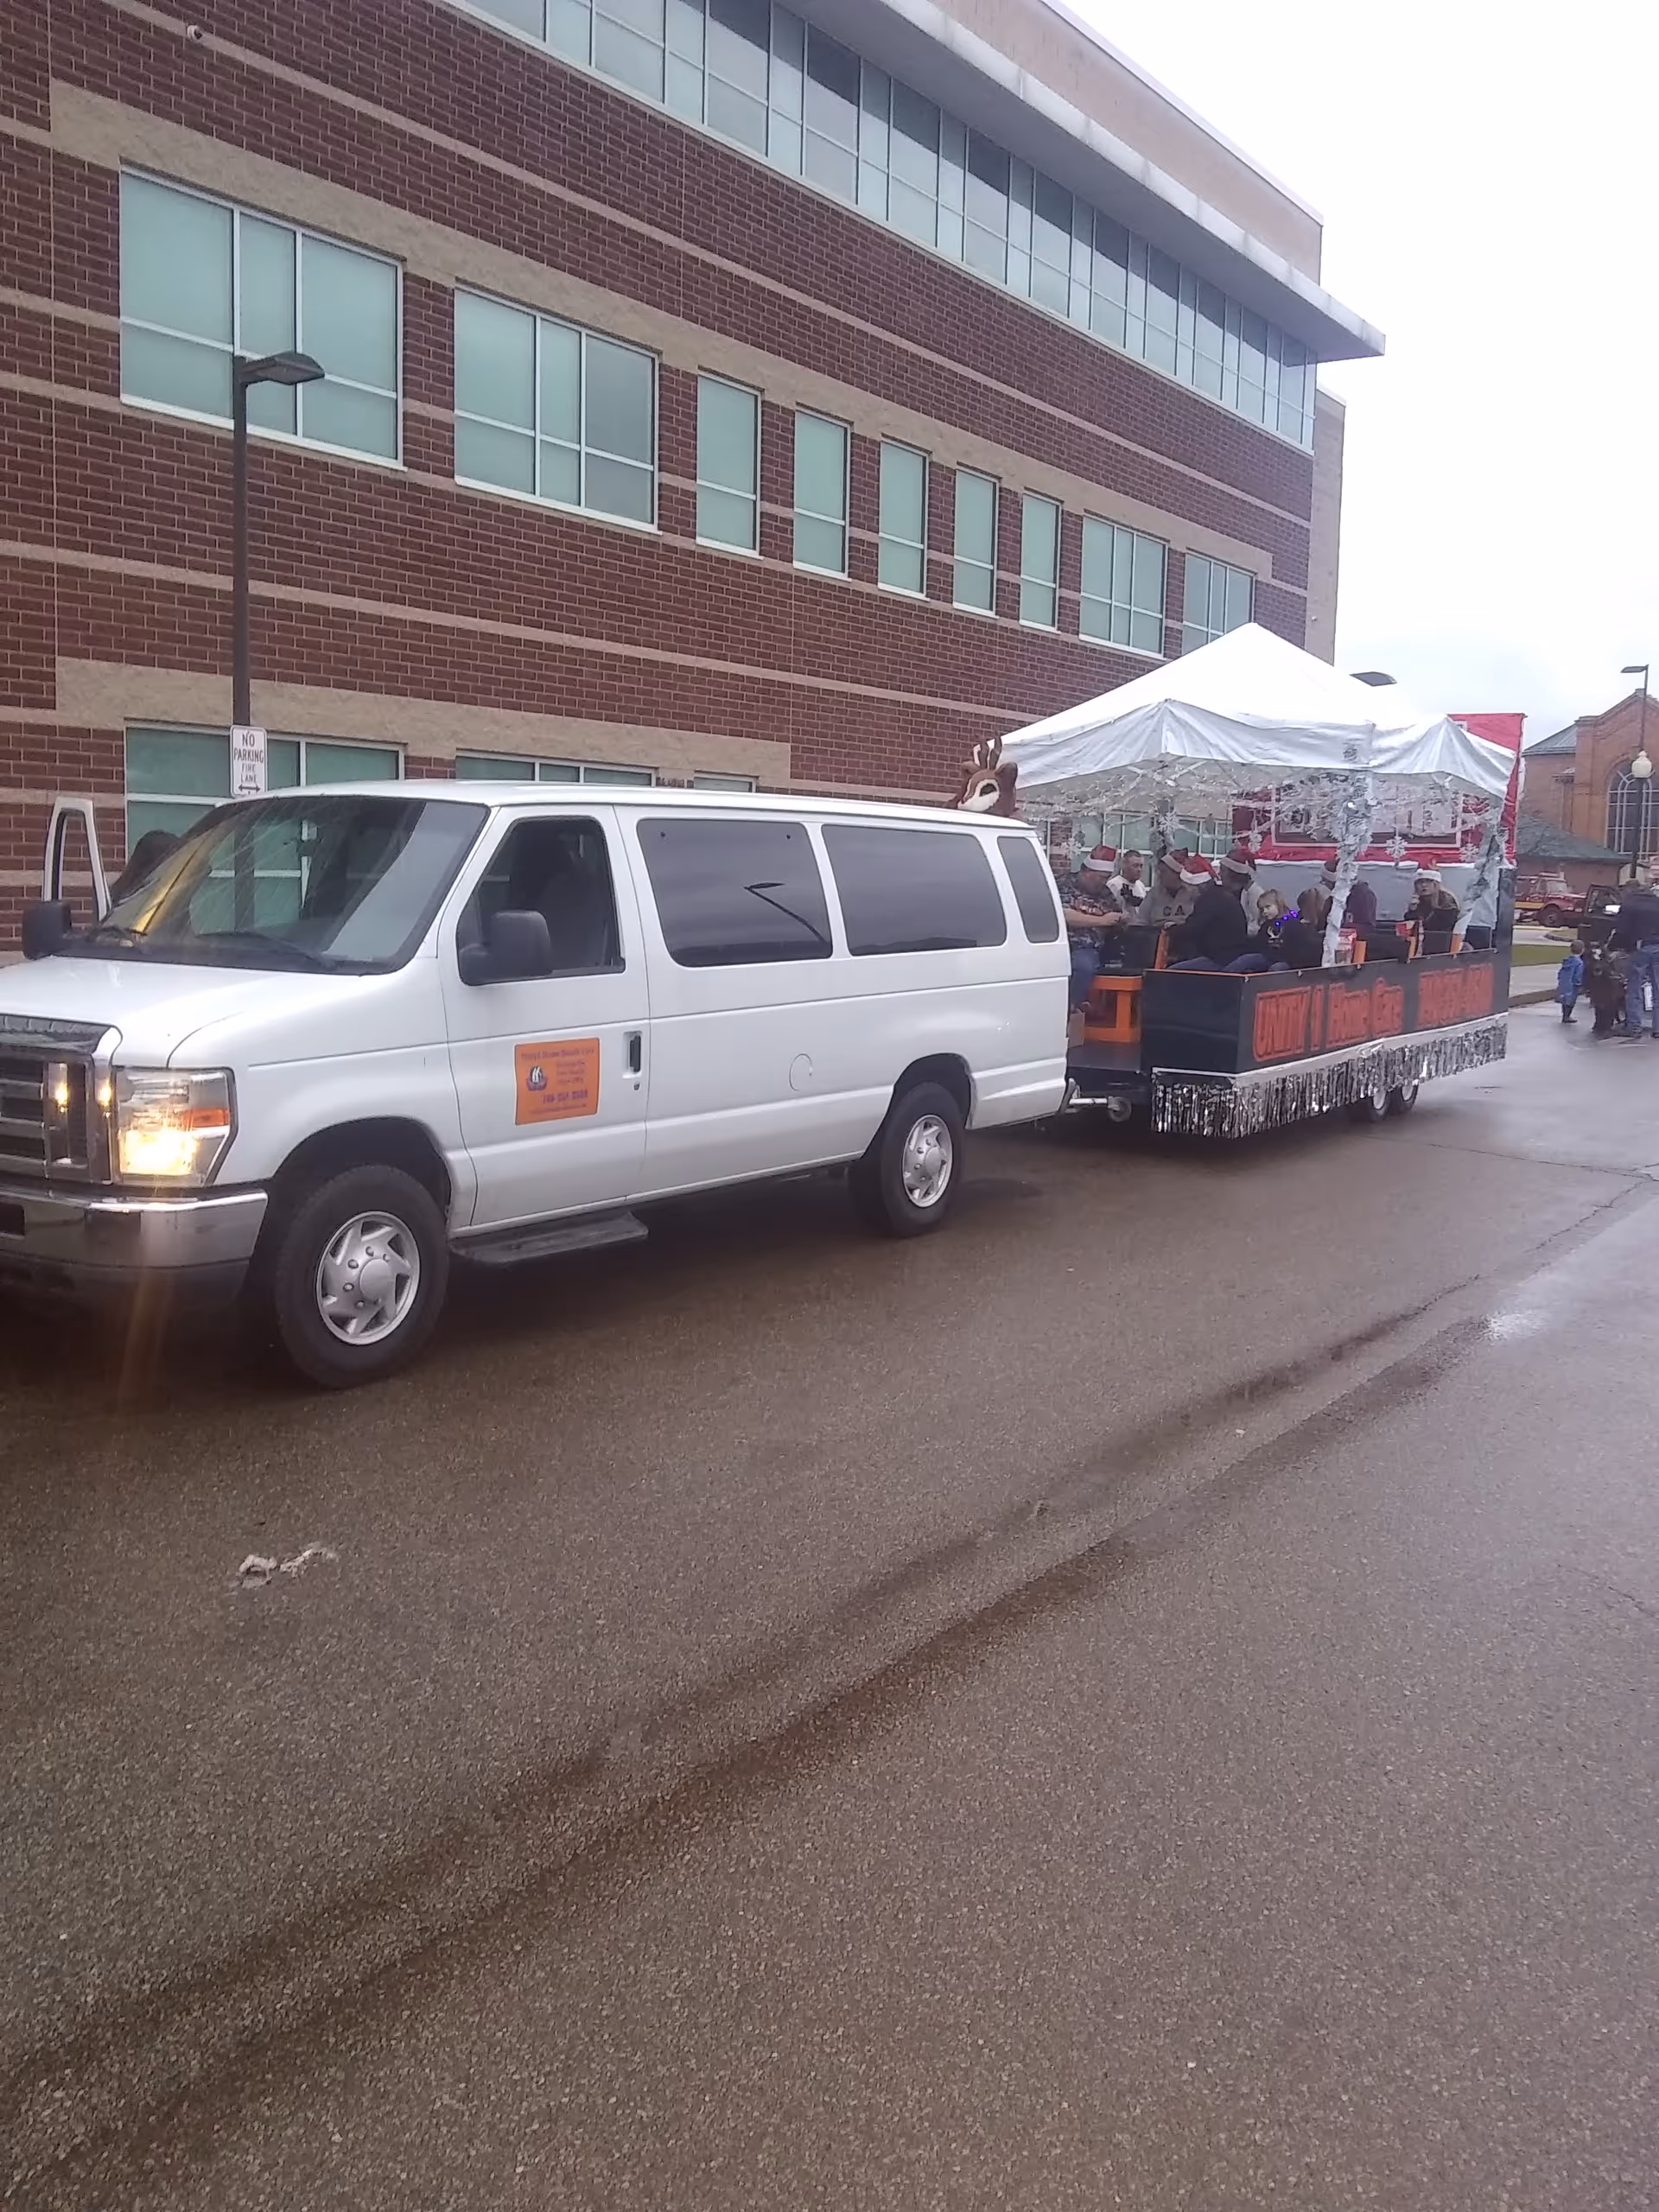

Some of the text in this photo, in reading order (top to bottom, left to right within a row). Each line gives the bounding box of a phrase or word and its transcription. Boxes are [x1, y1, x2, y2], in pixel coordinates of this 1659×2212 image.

[242, 733, 256, 747] NO
[233, 747, 264, 763] PARKING
[241, 763, 256, 772] FIRE
[240, 773, 257, 784] LANE
[1254, 987, 1310, 1060] UNITY
[1327, 982, 1369, 1046] Home
